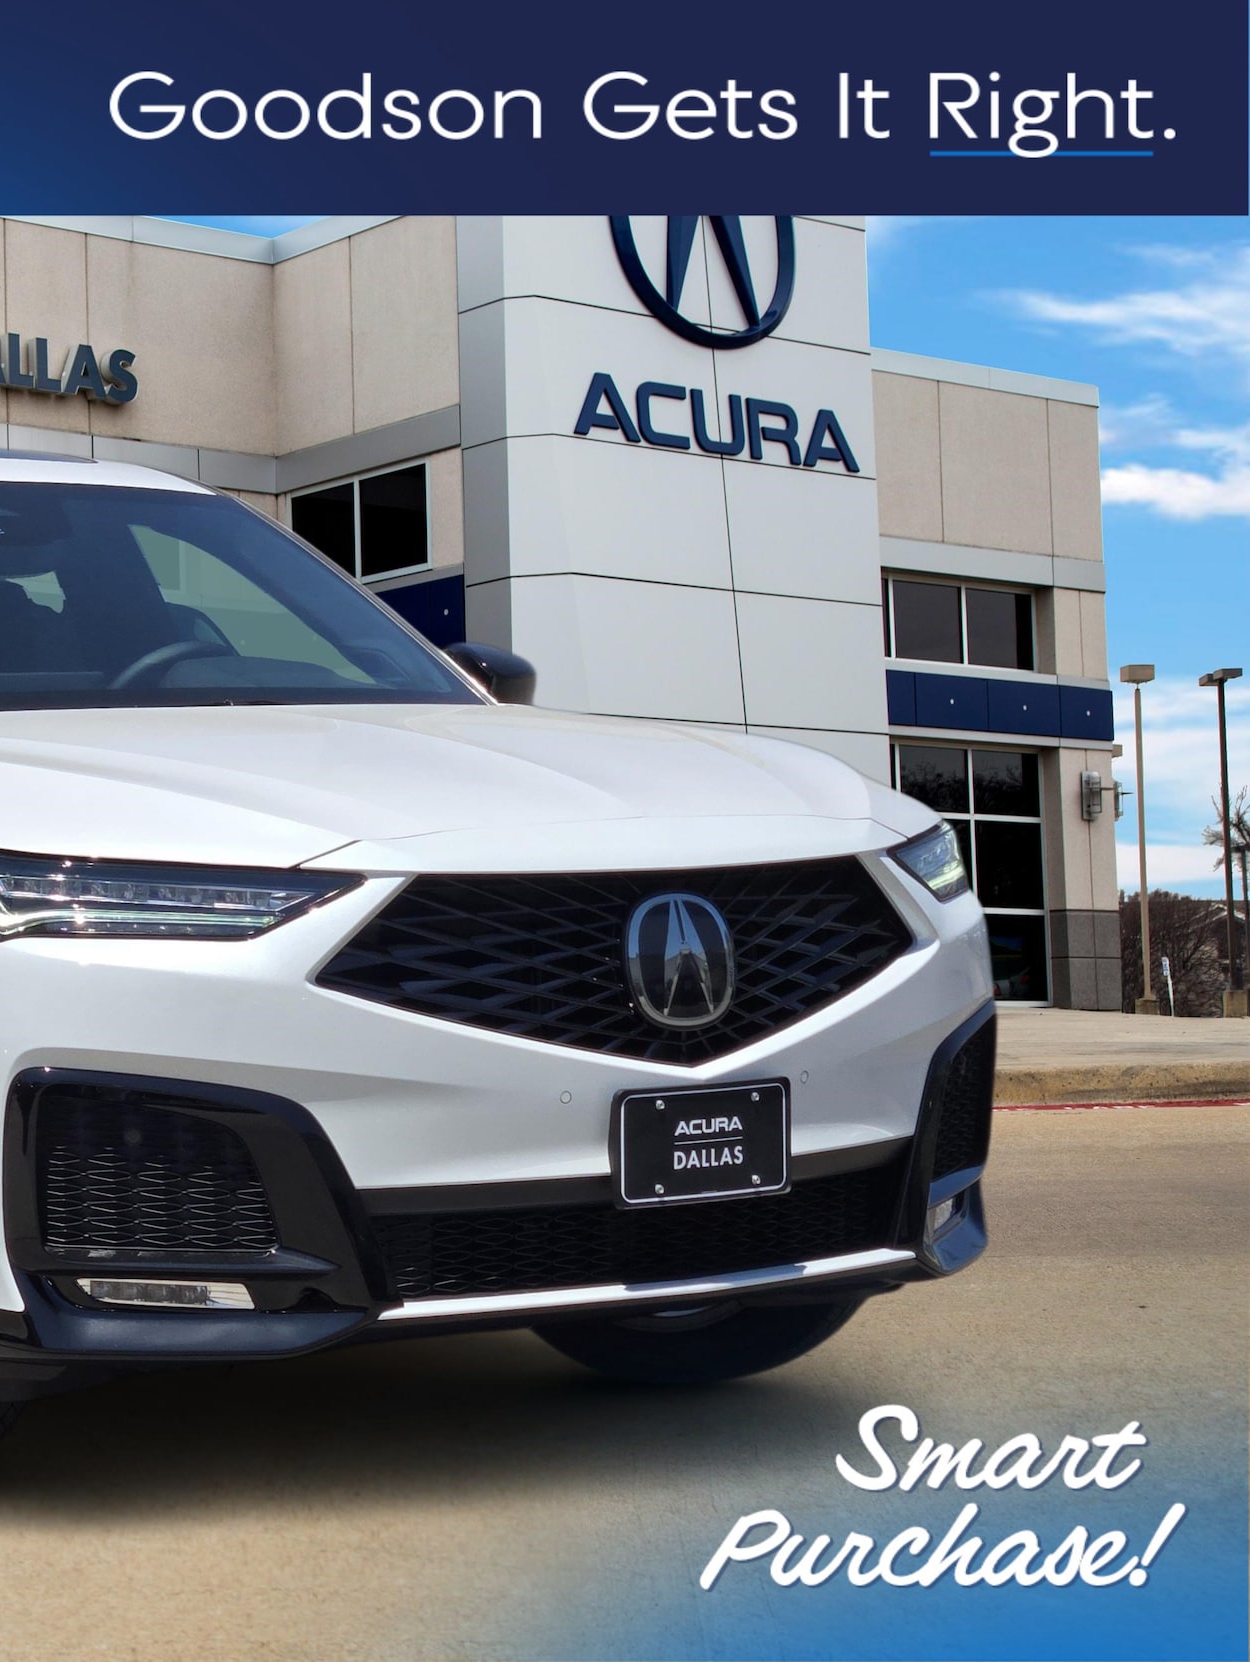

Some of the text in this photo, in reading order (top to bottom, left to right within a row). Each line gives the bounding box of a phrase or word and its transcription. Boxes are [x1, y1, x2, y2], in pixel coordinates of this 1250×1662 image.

[574, 372, 860, 474] ACURA
[674, 1116, 743, 1137] ACURA
[673, 1145, 744, 1170] DALLAS
